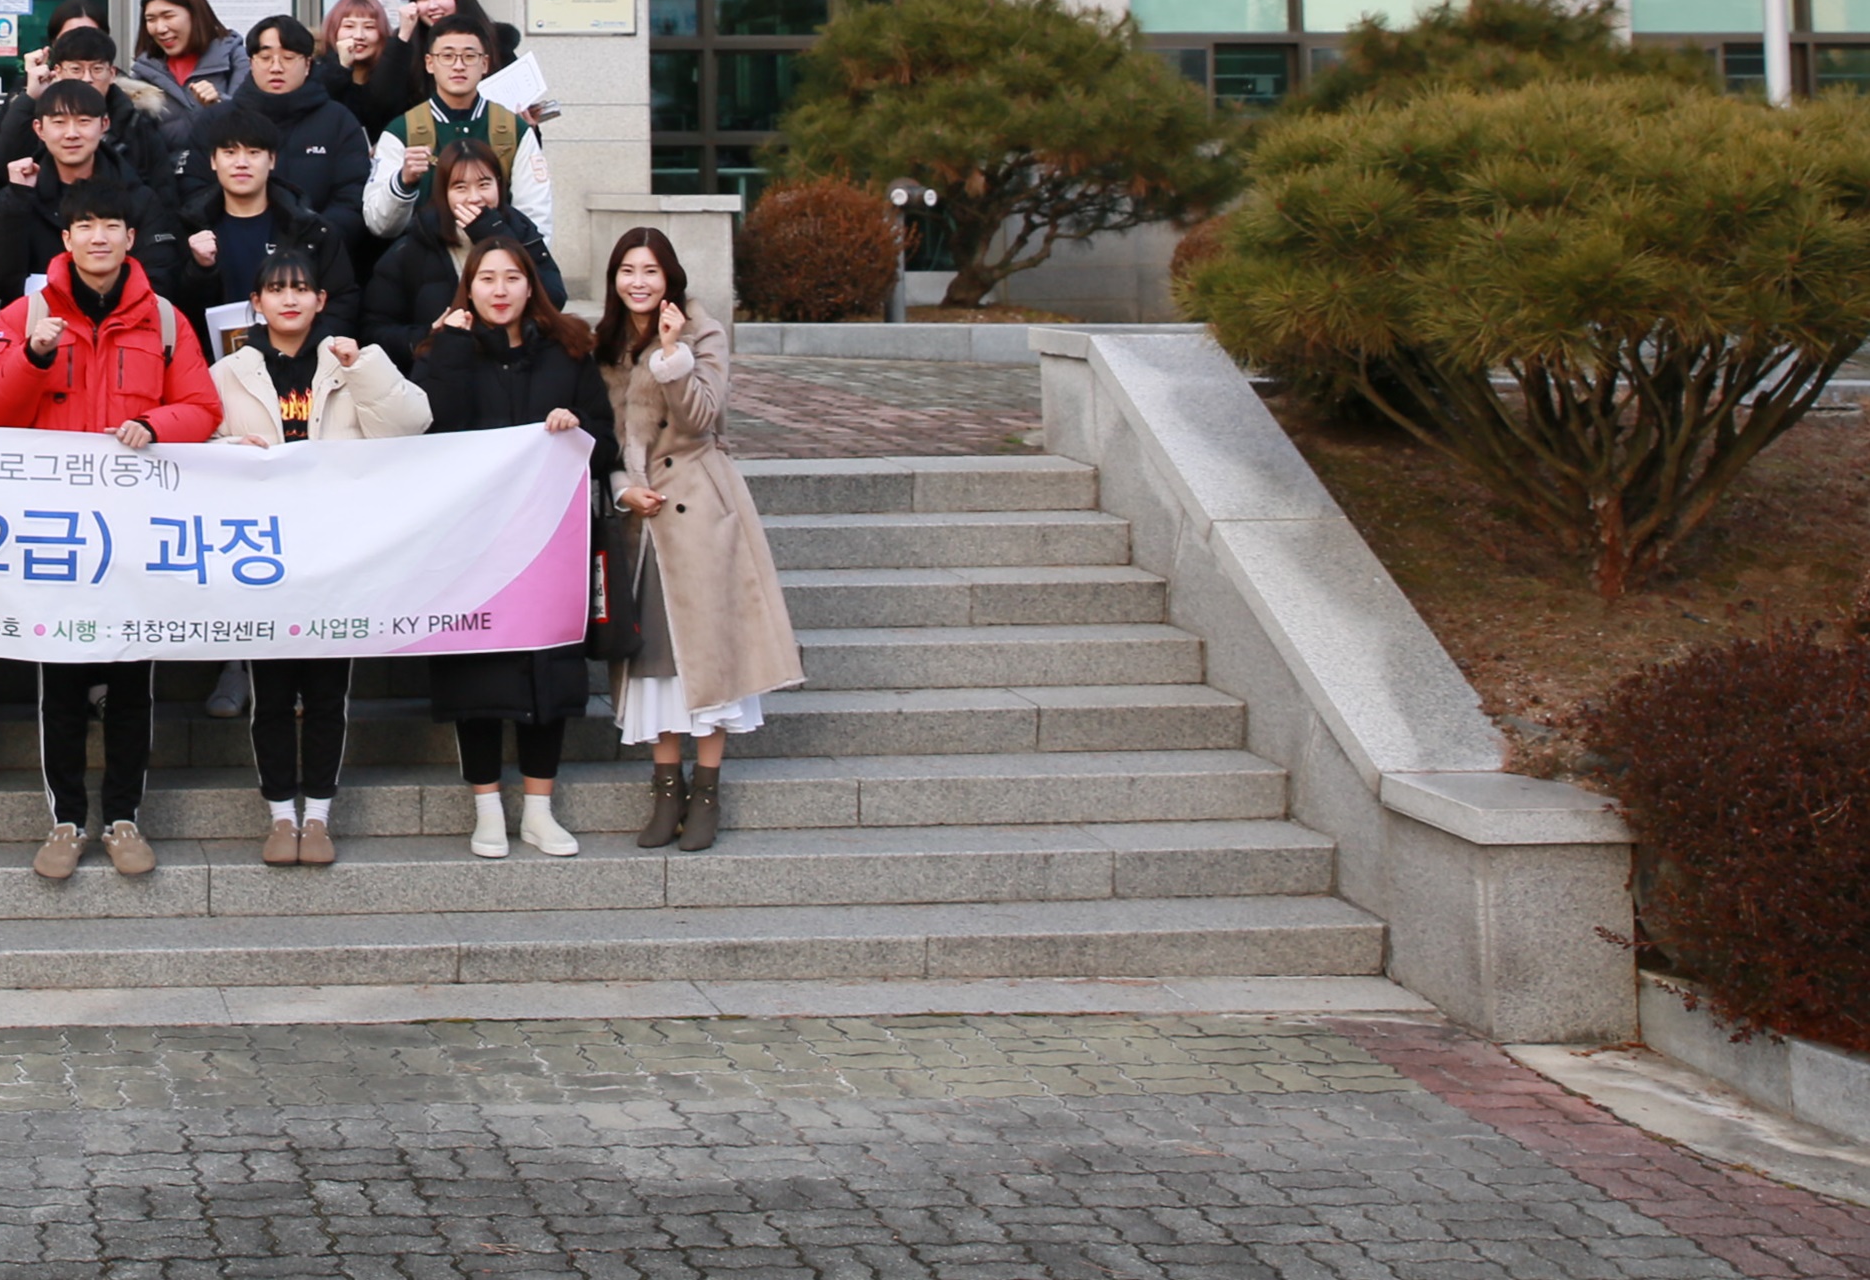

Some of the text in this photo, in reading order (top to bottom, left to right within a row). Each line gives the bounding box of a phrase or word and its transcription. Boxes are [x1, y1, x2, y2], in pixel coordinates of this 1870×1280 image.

[145, 515, 286, 586] 과정
[51, 619, 97, 643] 시행
[120, 619, 276, 643] 취창업지원센터
[305, 616, 371, 641] 사업명
[391, 616, 420, 635] KY
[427, 612, 493, 634] PRIME
